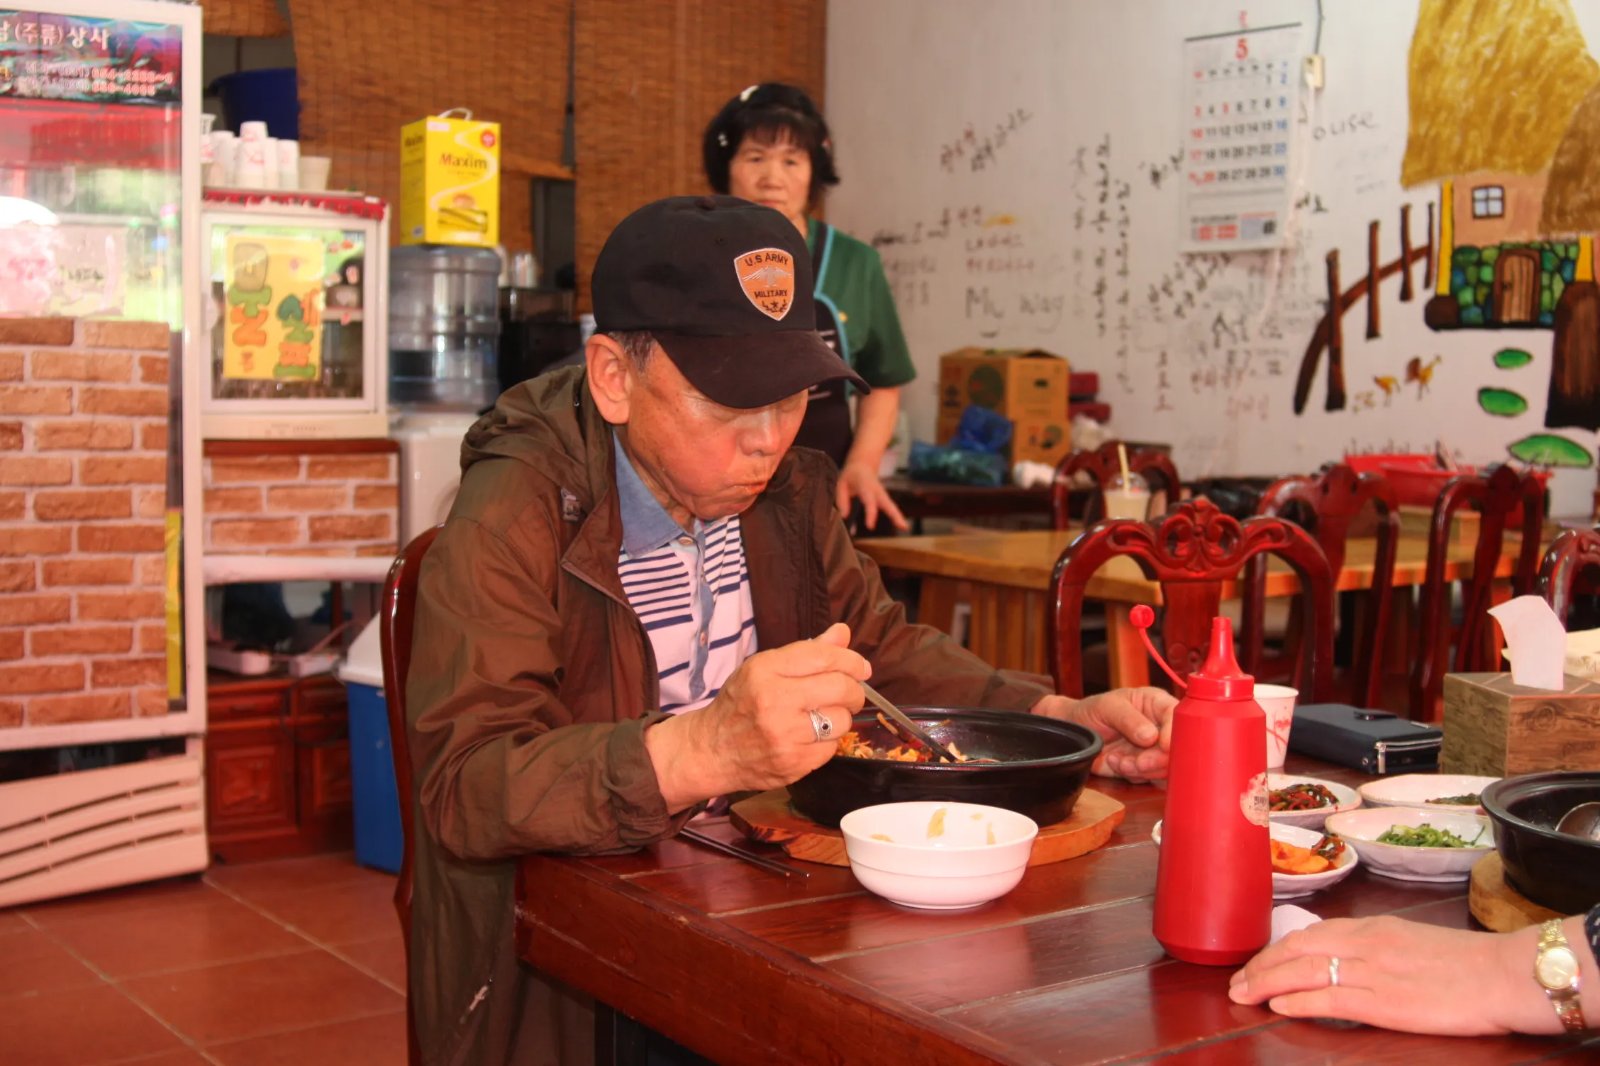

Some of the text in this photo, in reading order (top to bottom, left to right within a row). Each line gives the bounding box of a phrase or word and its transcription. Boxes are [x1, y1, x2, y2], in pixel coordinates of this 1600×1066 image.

[1235, 39, 1247, 61] 5
[440, 152, 489, 171] Maxim
[765, 252, 788, 265] ARMY
[754, 289, 788, 299] MILITARY
